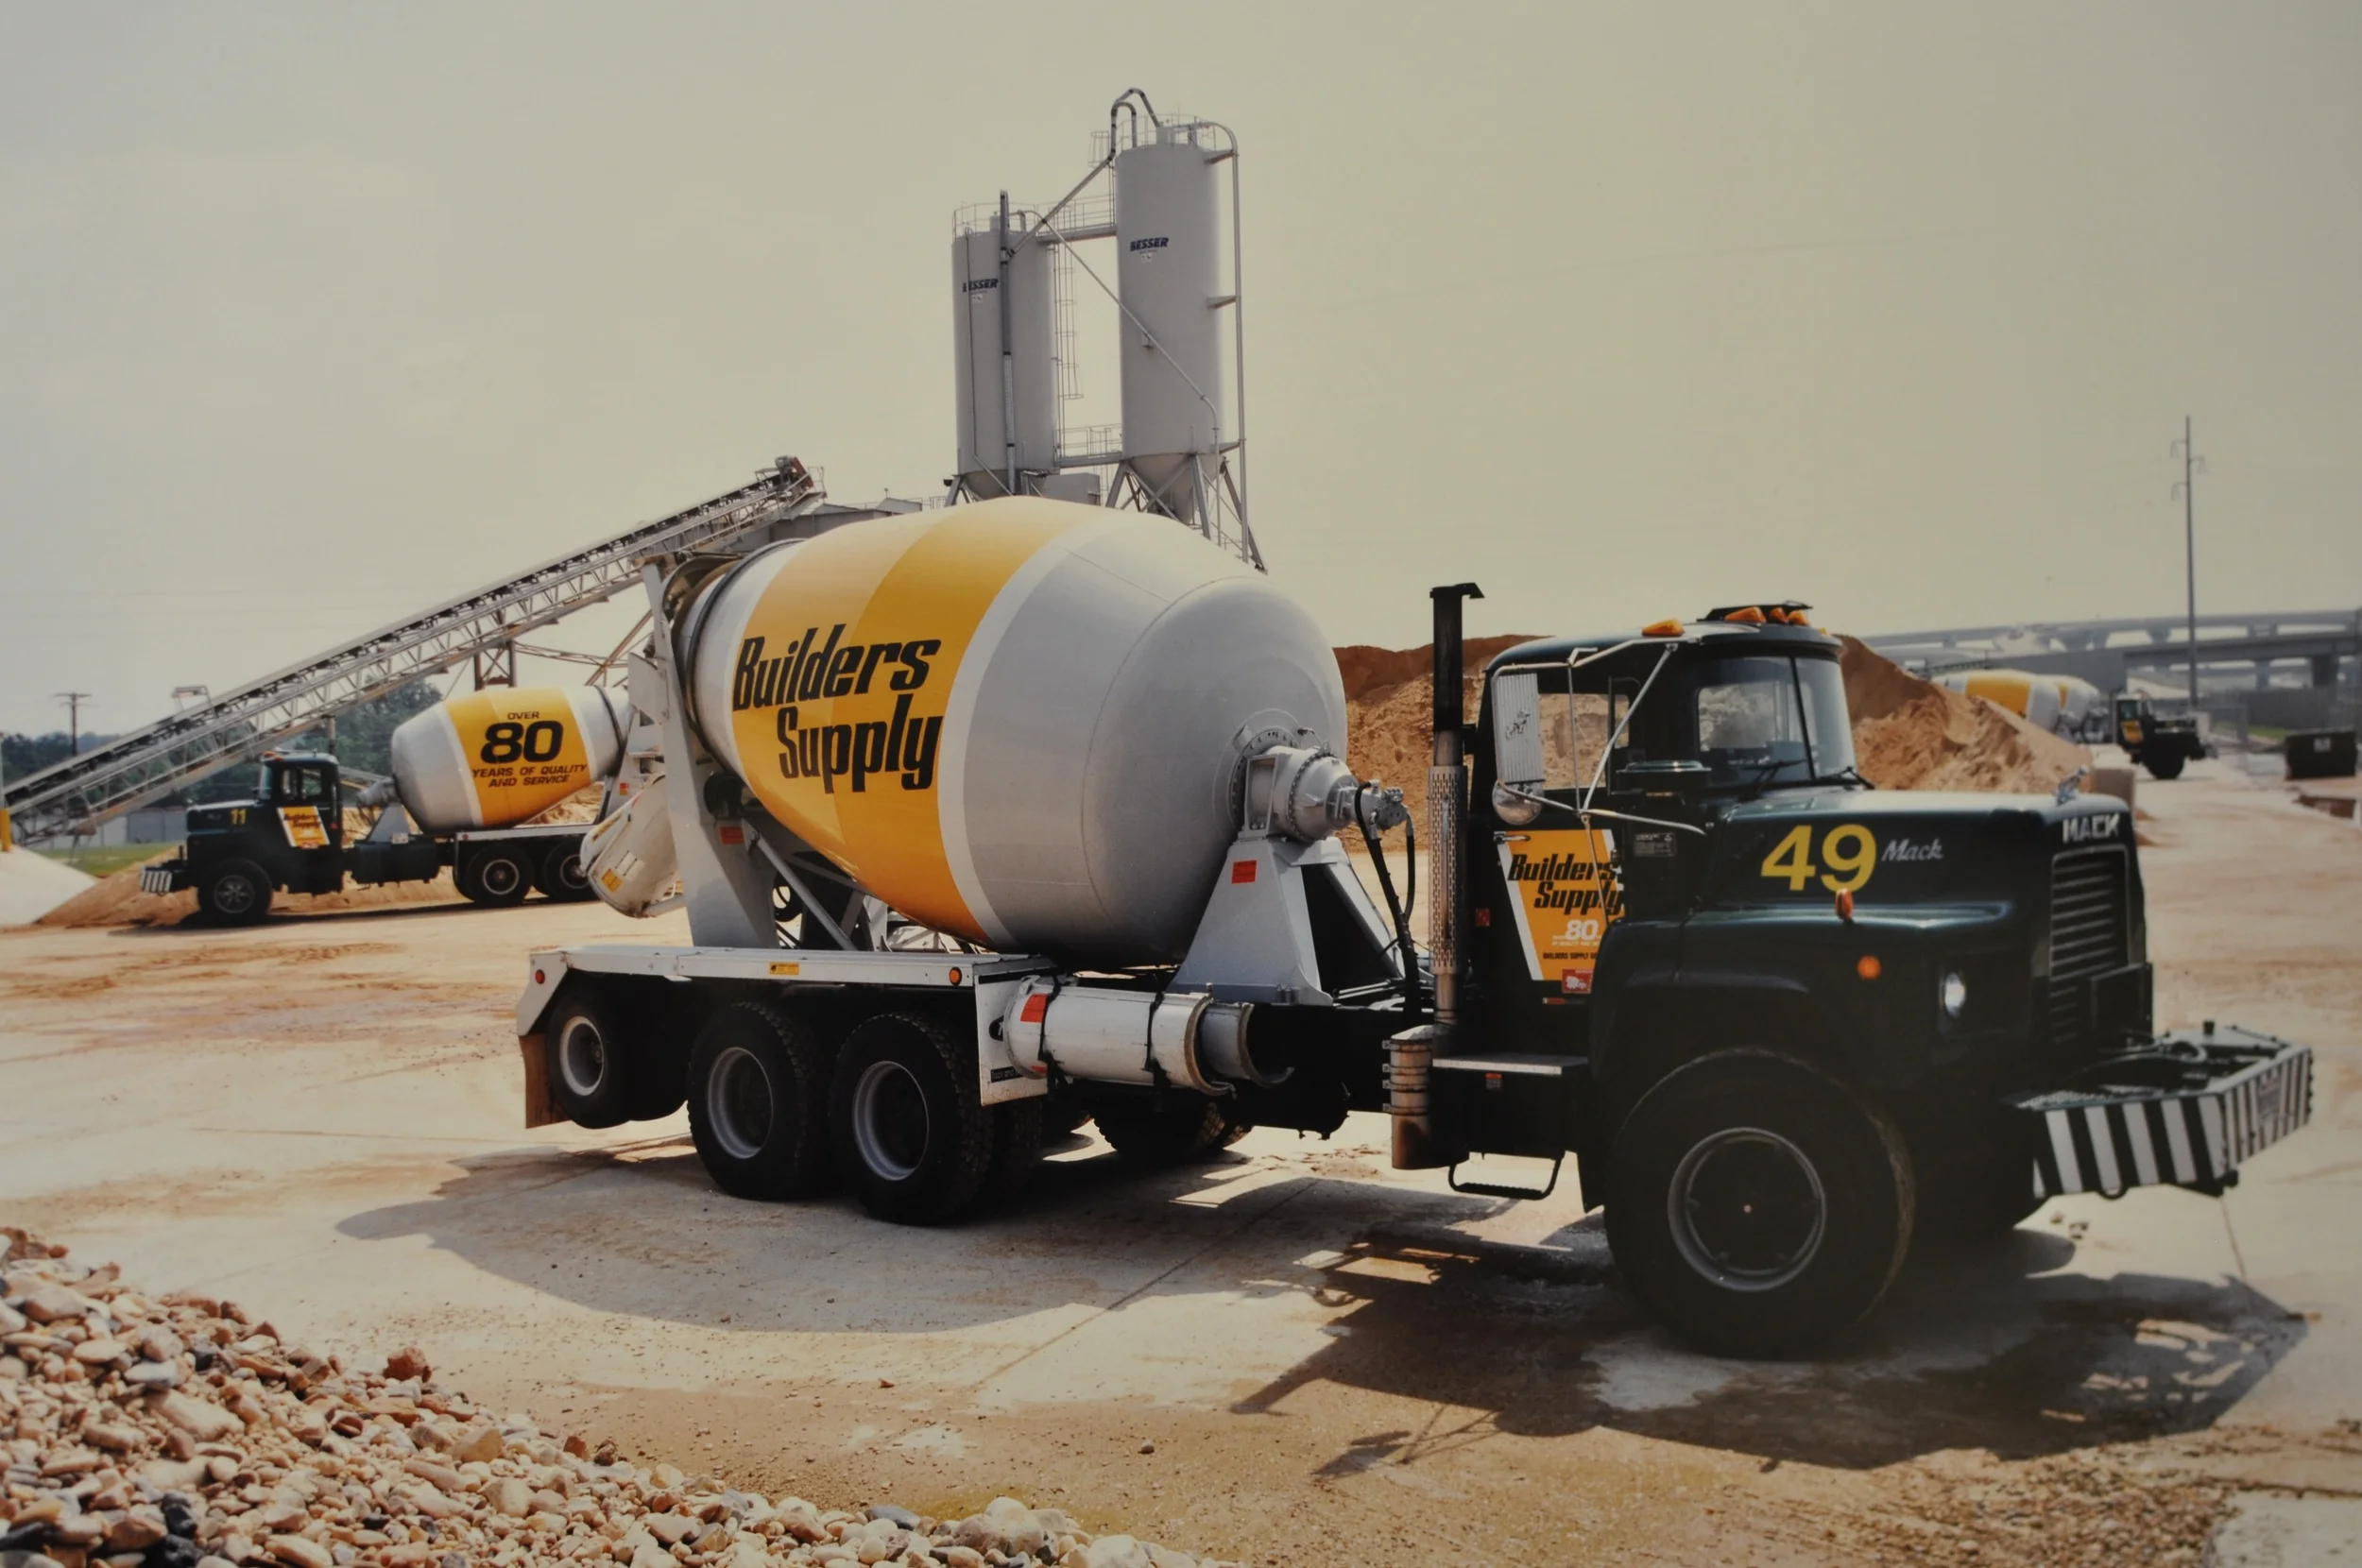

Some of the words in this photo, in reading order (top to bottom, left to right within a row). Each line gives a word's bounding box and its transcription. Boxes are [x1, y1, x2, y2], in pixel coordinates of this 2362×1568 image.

[732, 623, 941, 711] Builders
[507, 711, 539, 720] OVER
[480, 721, 564, 764] 80
[777, 693, 943, 793] Supply
[472, 767, 513, 778] YEARS
[520, 766, 535, 775] OF
[540, 764, 587, 775] QUALITY
[488, 778, 517, 788] AND
[522, 775, 570, 786] SERVICE
[2062, 813, 2119, 844] MACK
[1760, 825, 1876, 893] 49
[1881, 839, 1943, 861] Mack
[1508, 854, 1617, 880] Builders
[1534, 880, 1623, 915] Supply
[1565, 919, 1599, 941] 80
